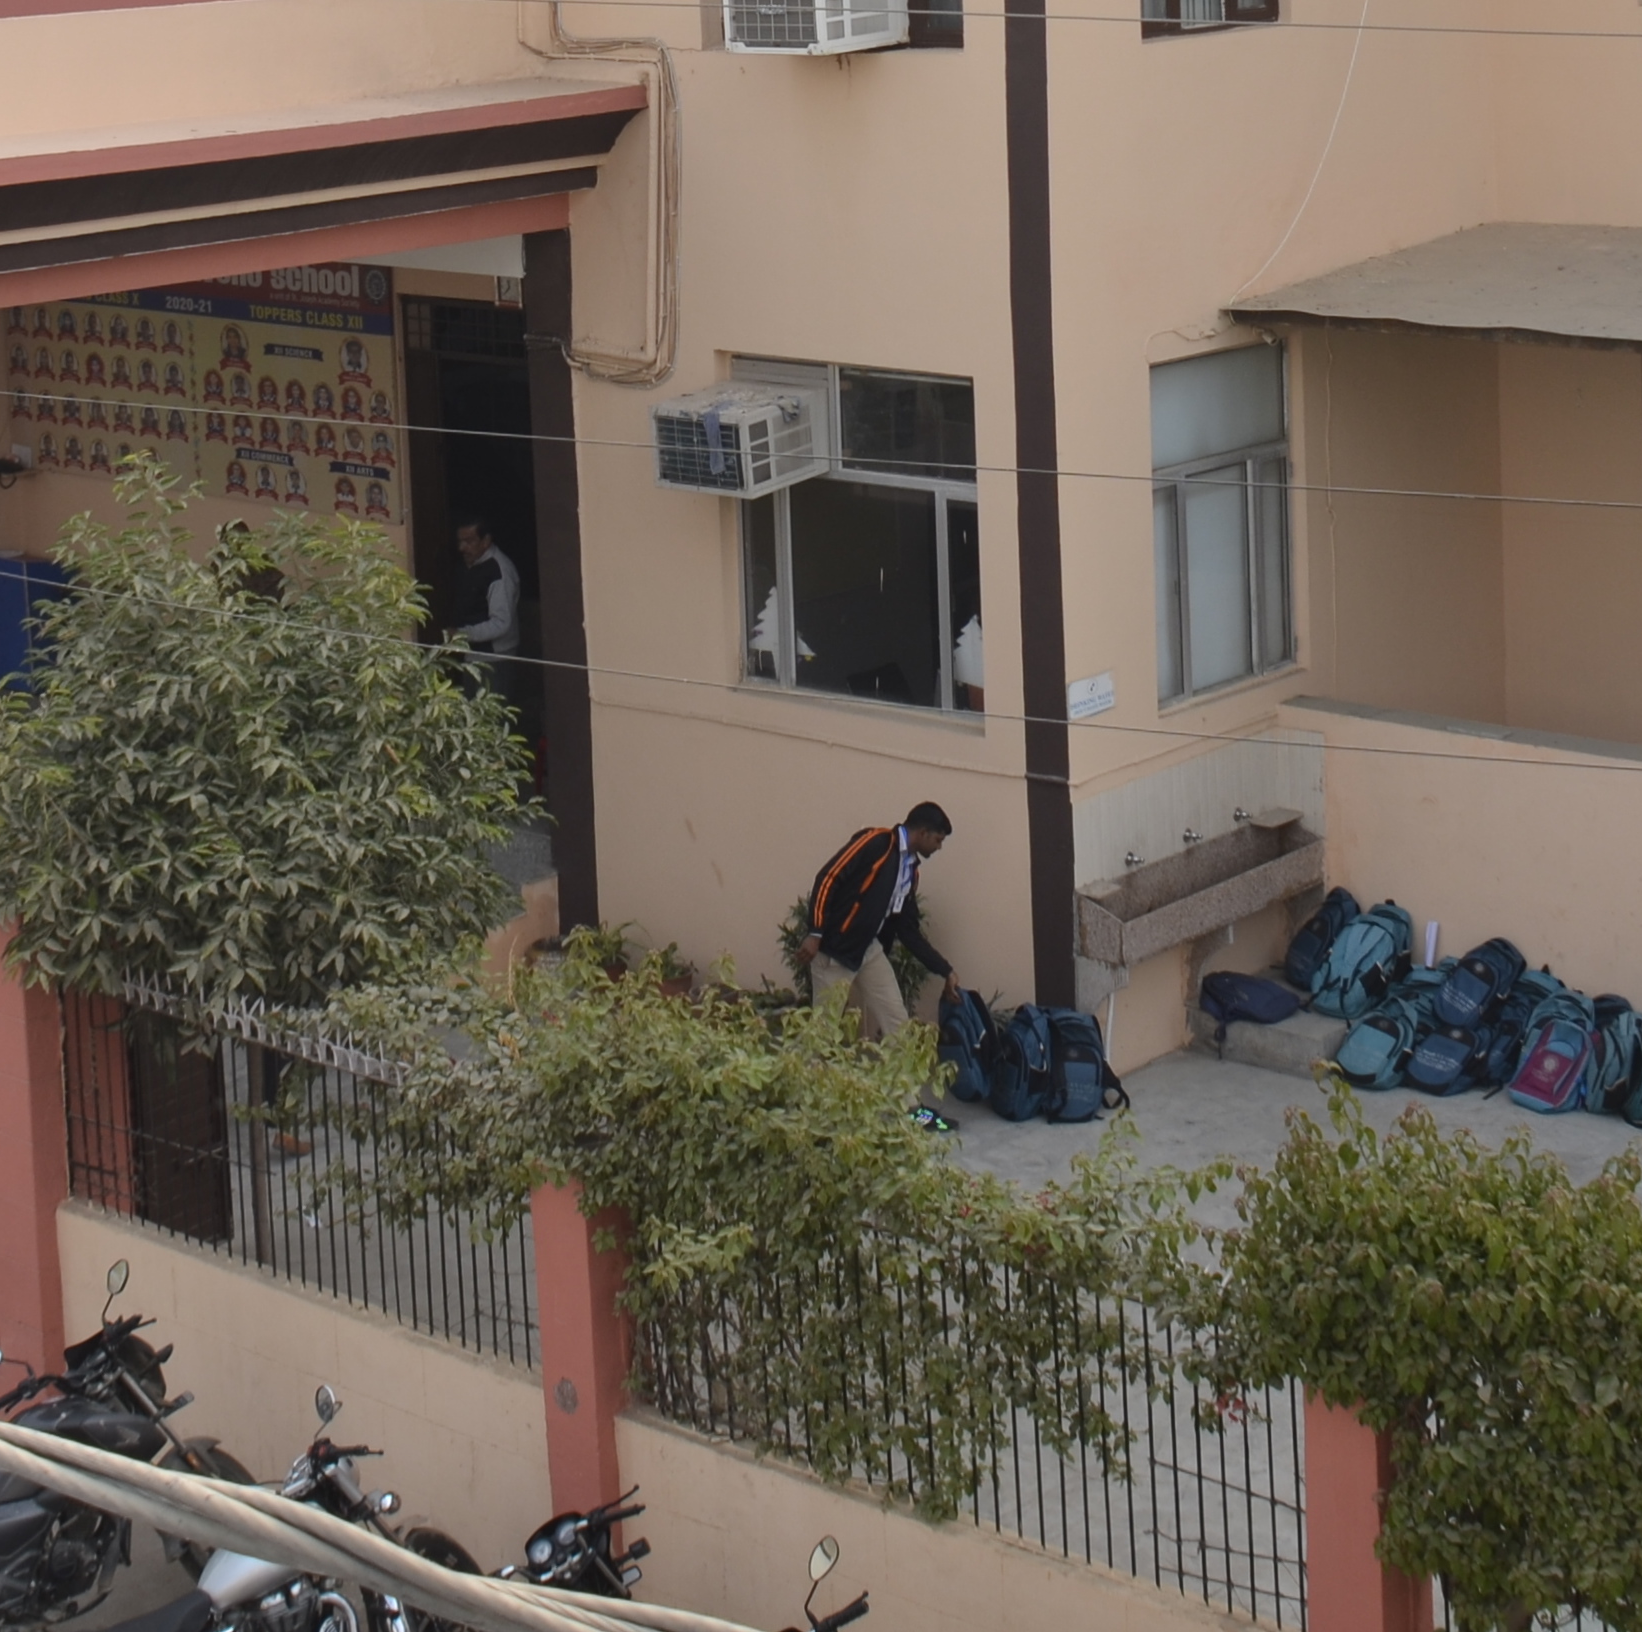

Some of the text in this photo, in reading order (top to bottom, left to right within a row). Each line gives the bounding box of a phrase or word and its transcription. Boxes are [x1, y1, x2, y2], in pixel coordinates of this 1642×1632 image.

[165, 295, 213, 314] 2020-21
[249, 304, 363, 330] TOPPERS CLASS XII
[356, 466, 374, 477] ARTS
